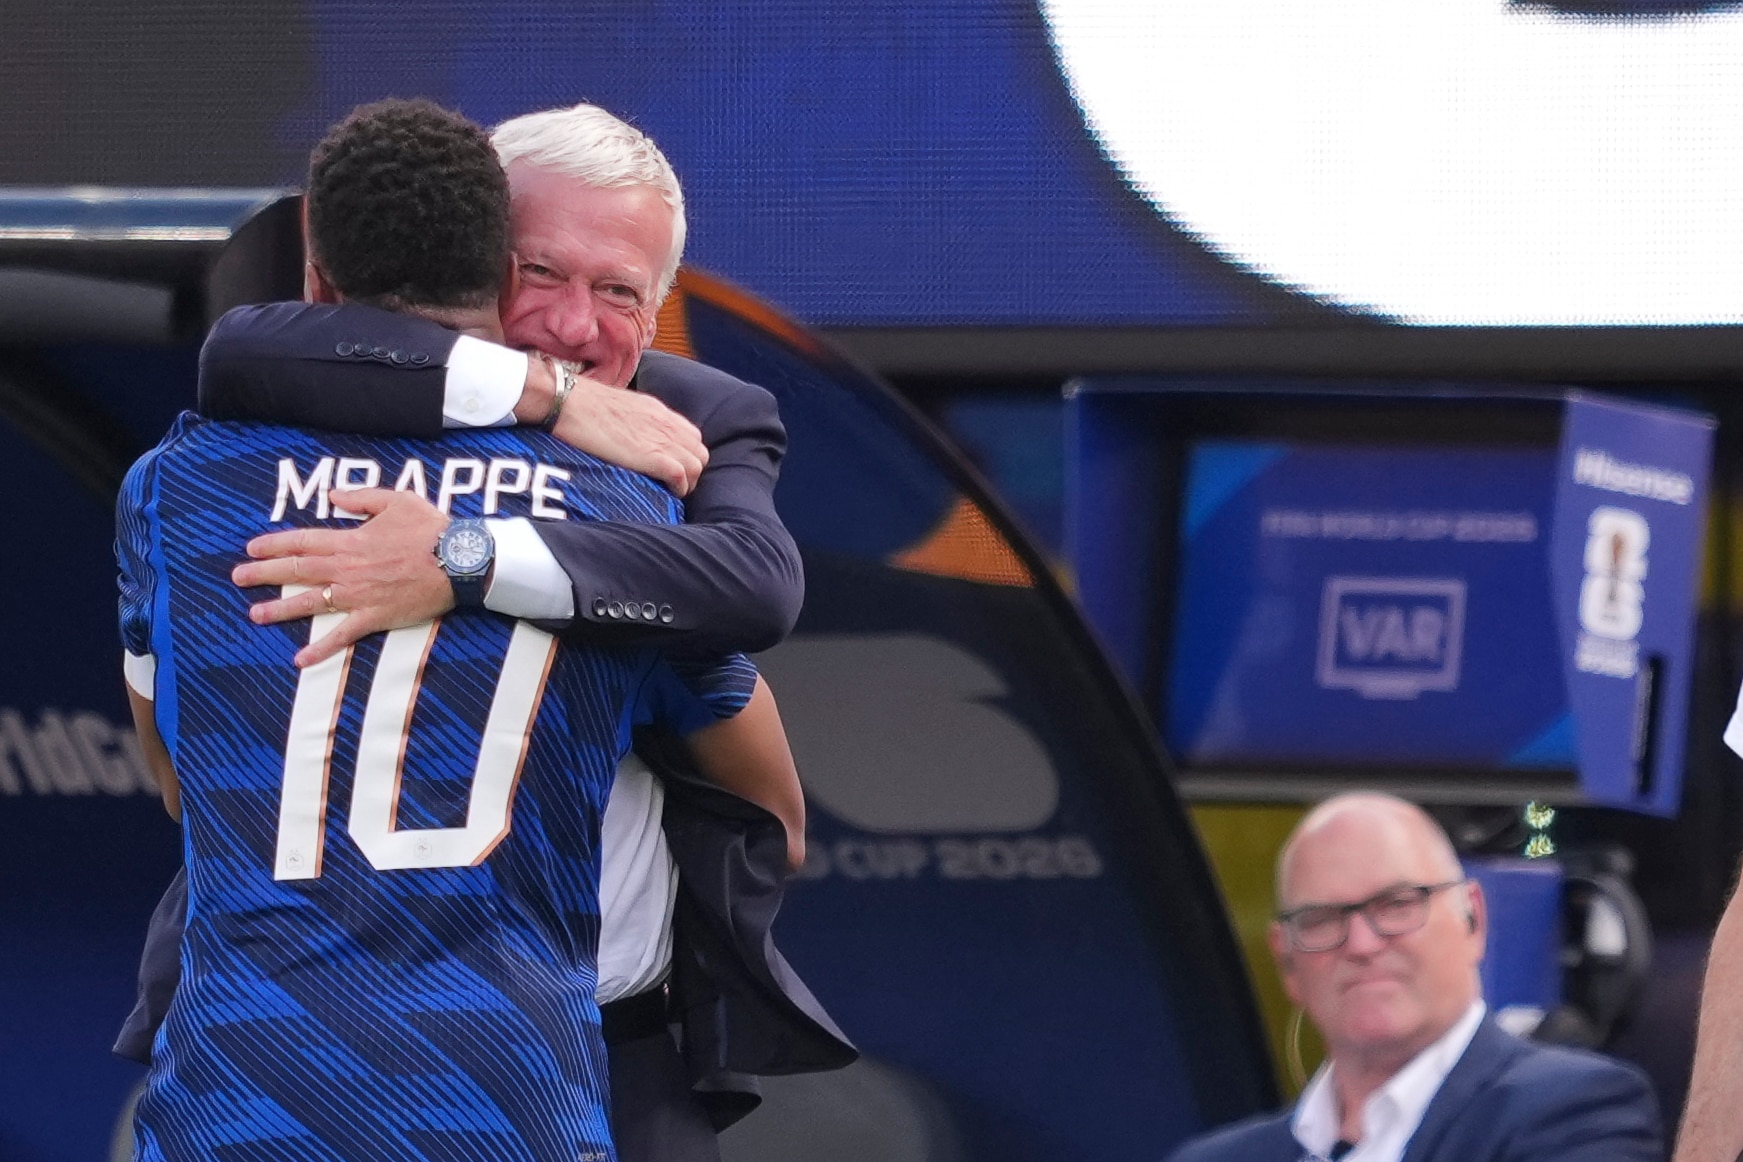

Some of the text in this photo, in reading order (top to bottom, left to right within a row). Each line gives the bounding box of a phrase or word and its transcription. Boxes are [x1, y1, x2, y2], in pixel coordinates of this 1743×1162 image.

[270, 457, 571, 521] MBAPPE
[1340, 604, 1445, 661] VAR
[274, 580, 559, 882] 10
[832, 838, 928, 879] CUP
[936, 837, 1103, 879] 2026
